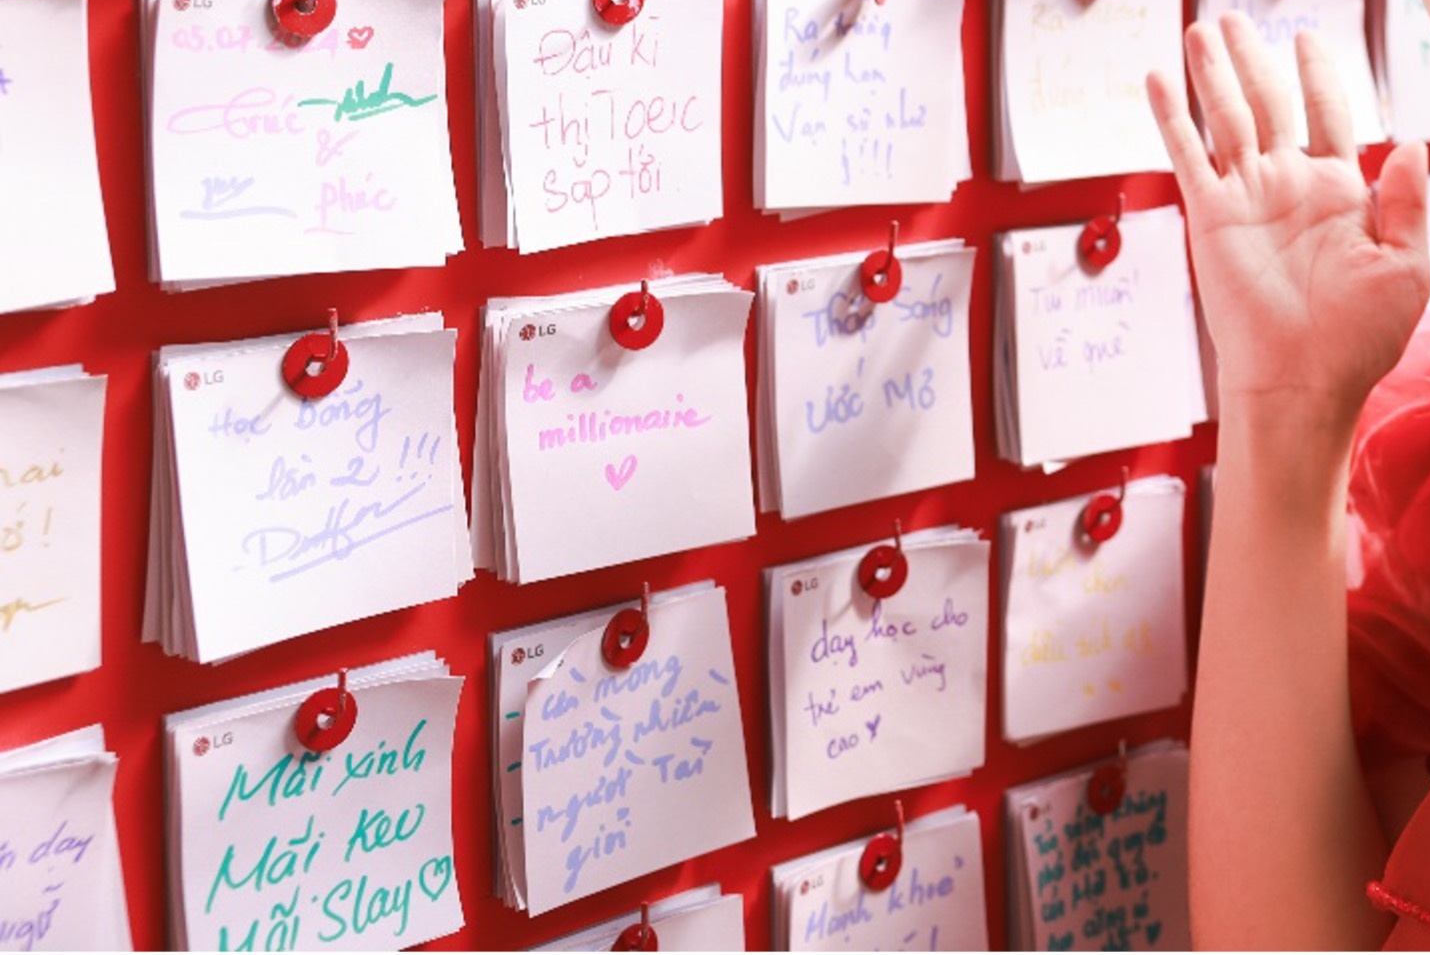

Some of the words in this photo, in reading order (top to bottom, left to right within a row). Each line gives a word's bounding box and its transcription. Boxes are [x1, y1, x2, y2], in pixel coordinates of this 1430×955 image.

[783, 6, 819, 44] Ra
[534, 29, 612, 79] Đậu
[771, 102, 827, 146] Vạn
[801, 279, 816, 291] LG
[539, 324, 556, 337] LG
[204, 370, 225, 385] LG
[523, 364, 556, 404] be
[570, 373, 598, 393] a
[539, 393, 713, 451] millionaire
[804, 577, 820, 591] LG
[526, 643, 545, 660] LG
[810, 619, 858, 669] dạy
[864, 598, 918, 643] học
[931, 597, 970, 631] cho
[594, 654, 683, 703] mong
[850, 680, 885, 703] em
[214, 732, 234, 748] LG
[333, 719, 428, 796] xinh
[826, 732, 861, 760] cao
[318, 875, 413, 943] Slay
